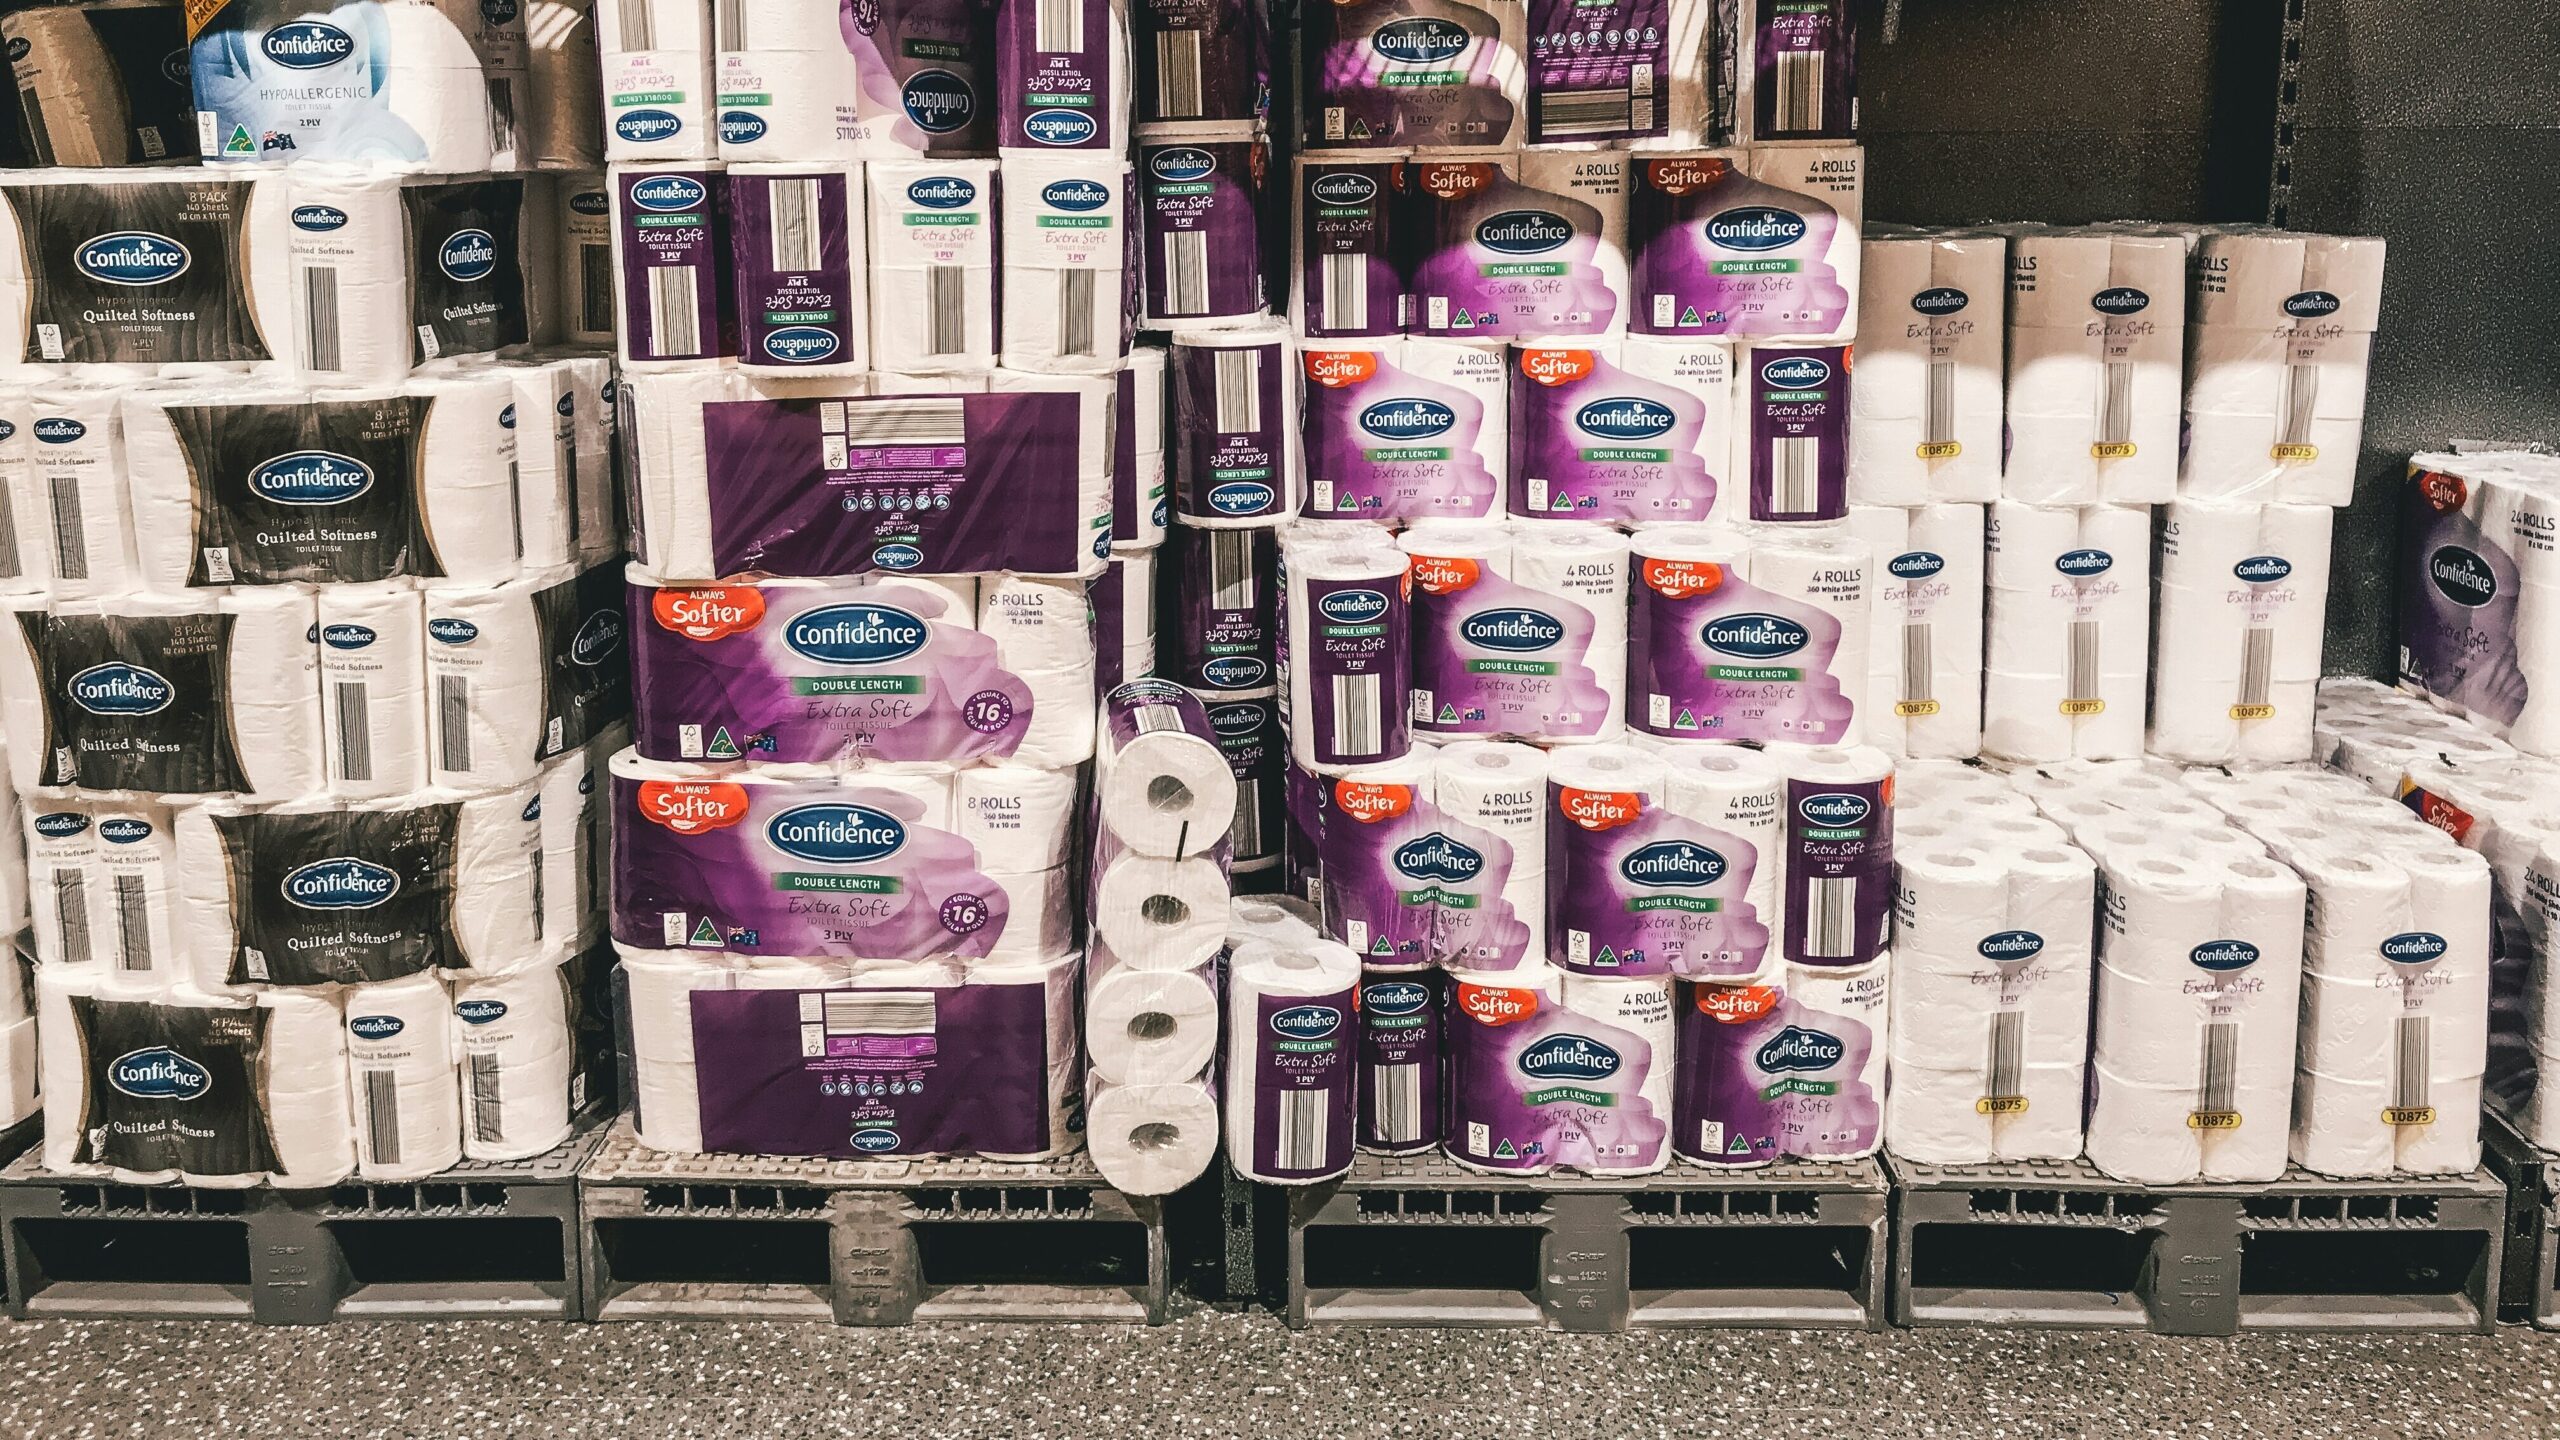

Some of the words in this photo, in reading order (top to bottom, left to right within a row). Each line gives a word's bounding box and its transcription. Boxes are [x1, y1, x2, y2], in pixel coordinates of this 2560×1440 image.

[267, 37, 346, 55] Confidence
[1379, 32, 1462, 49] Confidence
[1389, 75, 1420, 83] DOUBLE
[1423, 74, 1453, 82] LENGTH
[260, 87, 367, 100] HYPOALLERGENIC
[300, 119, 305, 127] 2
[307, 119, 320, 127] PLY
[1031, 121, 1090, 134] Confidence
[836, 127, 862, 140] ROLLS
[864, 127, 871, 139] 8
[1156, 157, 1210, 170] Confidence
[1441, 164, 1467, 172] ALWAYS
[1575, 164, 1583, 175] 4
[1587, 163, 1620, 175] ROLLS
[1430, 173, 1479, 189] Softer
[1659, 169, 1709, 185] Softer
[637, 186, 699, 200] Confidence
[911, 186, 972, 200] Confidence
[1046, 188, 1105, 201] Confidence
[1318, 182, 1371, 194] Confidence
[190, 192, 196, 202] 8
[200, 192, 228, 202] PACK
[1156, 199, 1185, 210] Extra
[1189, 196, 1214, 209] Soft
[201, 203, 229, 211] Sheets
[178, 212, 188, 220] 10
[209, 212, 217, 220] 11
[294, 211, 343, 223] Confidence
[641, 216, 666, 224] DOUBLE
[639, 229, 672, 242] Extra
[675, 228, 704, 242] Soft
[1482, 224, 1566, 240] Confidence
[1711, 222, 1798, 238] Confidence
[85, 248, 181, 268] Confidence
[446, 242, 493, 266] Confidence
[660, 251, 666, 259] 3
[668, 251, 681, 259] PLY
[1722, 262, 1753, 271] DOUBLE
[1756, 262, 1786, 270] LENGTH
[1916, 294, 1964, 308] Confidence
[2096, 292, 2145, 307] Confidence
[2287, 296, 2335, 310] Confidence
[83, 310, 137, 323] Quilted
[141, 309, 195, 321] Softness
[1907, 324, 1941, 338] Extra
[1946, 321, 1974, 335] Soft
[771, 338, 832, 352] Confidence
[1457, 354, 1465, 365] 4
[1468, 352, 1500, 365] ROLLS
[1314, 361, 1362, 376] Softer
[1530, 359, 1580, 375] Softer
[1768, 366, 1824, 379] Confidence
[1365, 411, 1448, 427] Confidence
[1582, 411, 1669, 427] Confidence
[35, 423, 81, 436] Confidence
[1593, 451, 1624, 460] DOUBLE
[1627, 451, 1657, 460] LENGTH
[1922, 445, 1955, 455] 10875
[2098, 445, 2130, 455] 10875
[2276, 446, 2312, 457] 10875
[261, 468, 361, 489] Confidence
[2511, 510, 2522, 523] 24
[2523, 512, 2555, 531] ROLLS
[257, 530, 315, 545] Quilted
[320, 528, 378, 541] Softness
[878, 552, 918, 564] Confidence
[1892, 559, 1940, 571] Confidence
[2060, 555, 2109, 569] Confidence
[1415, 566, 1464, 583] Softer
[1567, 565, 1575, 577] 4
[1578, 564, 1614, 576] ROLLS
[2238, 563, 2287, 575] Confidence
[2434, 558, 2490, 594] Confidence
[1653, 569, 1707, 588] Softer
[690, 591, 726, 600] ALWAYS
[989, 594, 997, 606] 8
[1002, 593, 1044, 606] ROLLS
[672, 601, 746, 623] Softer
[1020, 609, 1043, 617] Sheets
[1325, 599, 1383, 613] Confidence
[795, 623, 917, 645] Confidence
[1468, 620, 1557, 638] Confidence
[1708, 626, 1800, 645] Confidence
[1325, 640, 1358, 652] Extra
[1361, 638, 1386, 651] Soft
[812, 681, 857, 691] DOUBLE
[860, 680, 903, 690] LENGTH
[976, 691, 999, 700] EQUAL
[807, 701, 861, 720] Extra
[869, 698, 913, 719] Soft
[976, 702, 1001, 721] 16
[1902, 703, 1933, 714] 10875
[2066, 702, 2098, 712] 10875
[2236, 707, 2268, 717] 10875
[81, 739, 129, 752] Quilted
[674, 785, 710, 795] ALWAYS
[657, 794, 729, 818] Softer
[968, 797, 976, 809] 8
[980, 796, 1021, 809] ROLLS
[1345, 794, 1396, 810] Softer
[1571, 799, 1626, 819] Softer
[1806, 802, 1864, 816] Confidence
[102, 824, 147, 837] Confidence
[777, 821, 896, 845] Confidence
[1628, 856, 1719, 876] Confidence
[294, 872, 387, 895] Confidence
[794, 877, 837, 888] DOUBLE
[840, 879, 881, 890] LENGTH
[789, 896, 840, 916] Extra
[847, 898, 891, 918] Soft
[952, 905, 976, 924] 16
[287, 933, 343, 951] Quilted
[349, 930, 402, 944] Softness
[824, 929, 831, 940] 3
[834, 931, 854, 941] PLY
[1983, 939, 2039, 953] Confidence
[2385, 940, 2442, 954] Confidence
[2195, 948, 2253, 962] Confidence
[1367, 990, 1425, 1004] Confidence
[1481, 989, 1508, 997] ALWAYS
[1624, 994, 1632, 1005] 4
[1635, 990, 1669, 1005] ROLLS
[1468, 996, 1523, 1013] Softer
[1706, 995, 1762, 1013] Softer
[1277, 1015, 1335, 1029] Confidence
[1525, 1049, 1614, 1070] Confidence
[1984, 1100, 2021, 1111] 10875
[2196, 1115, 2234, 1126] 10875
[2390, 1111, 2429, 1122] 10875
[114, 1119, 166, 1135] Quilted
